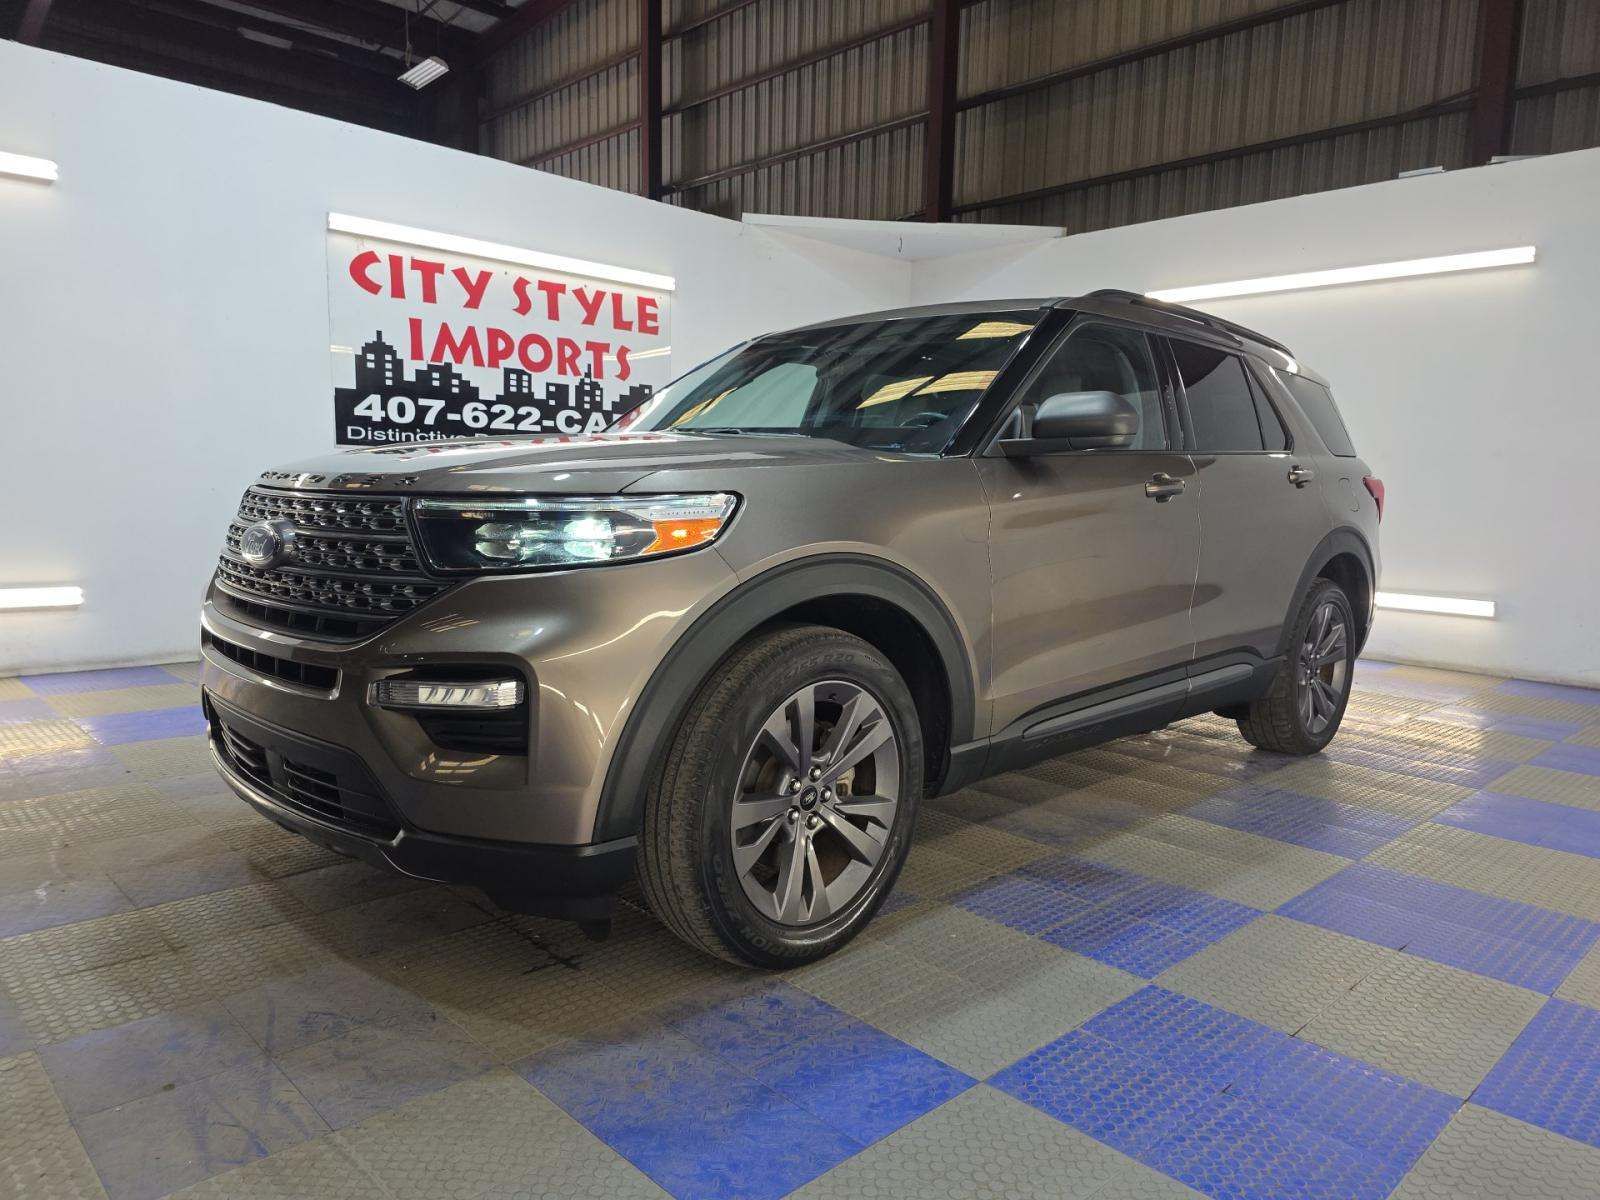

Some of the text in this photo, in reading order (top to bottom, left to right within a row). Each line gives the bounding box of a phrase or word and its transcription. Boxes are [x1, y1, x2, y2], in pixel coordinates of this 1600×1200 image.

[349, 250, 660, 336] CITY STYLE
[408, 317, 632, 382] IMPORTS
[353, 394, 621, 434] 407-622-CA
